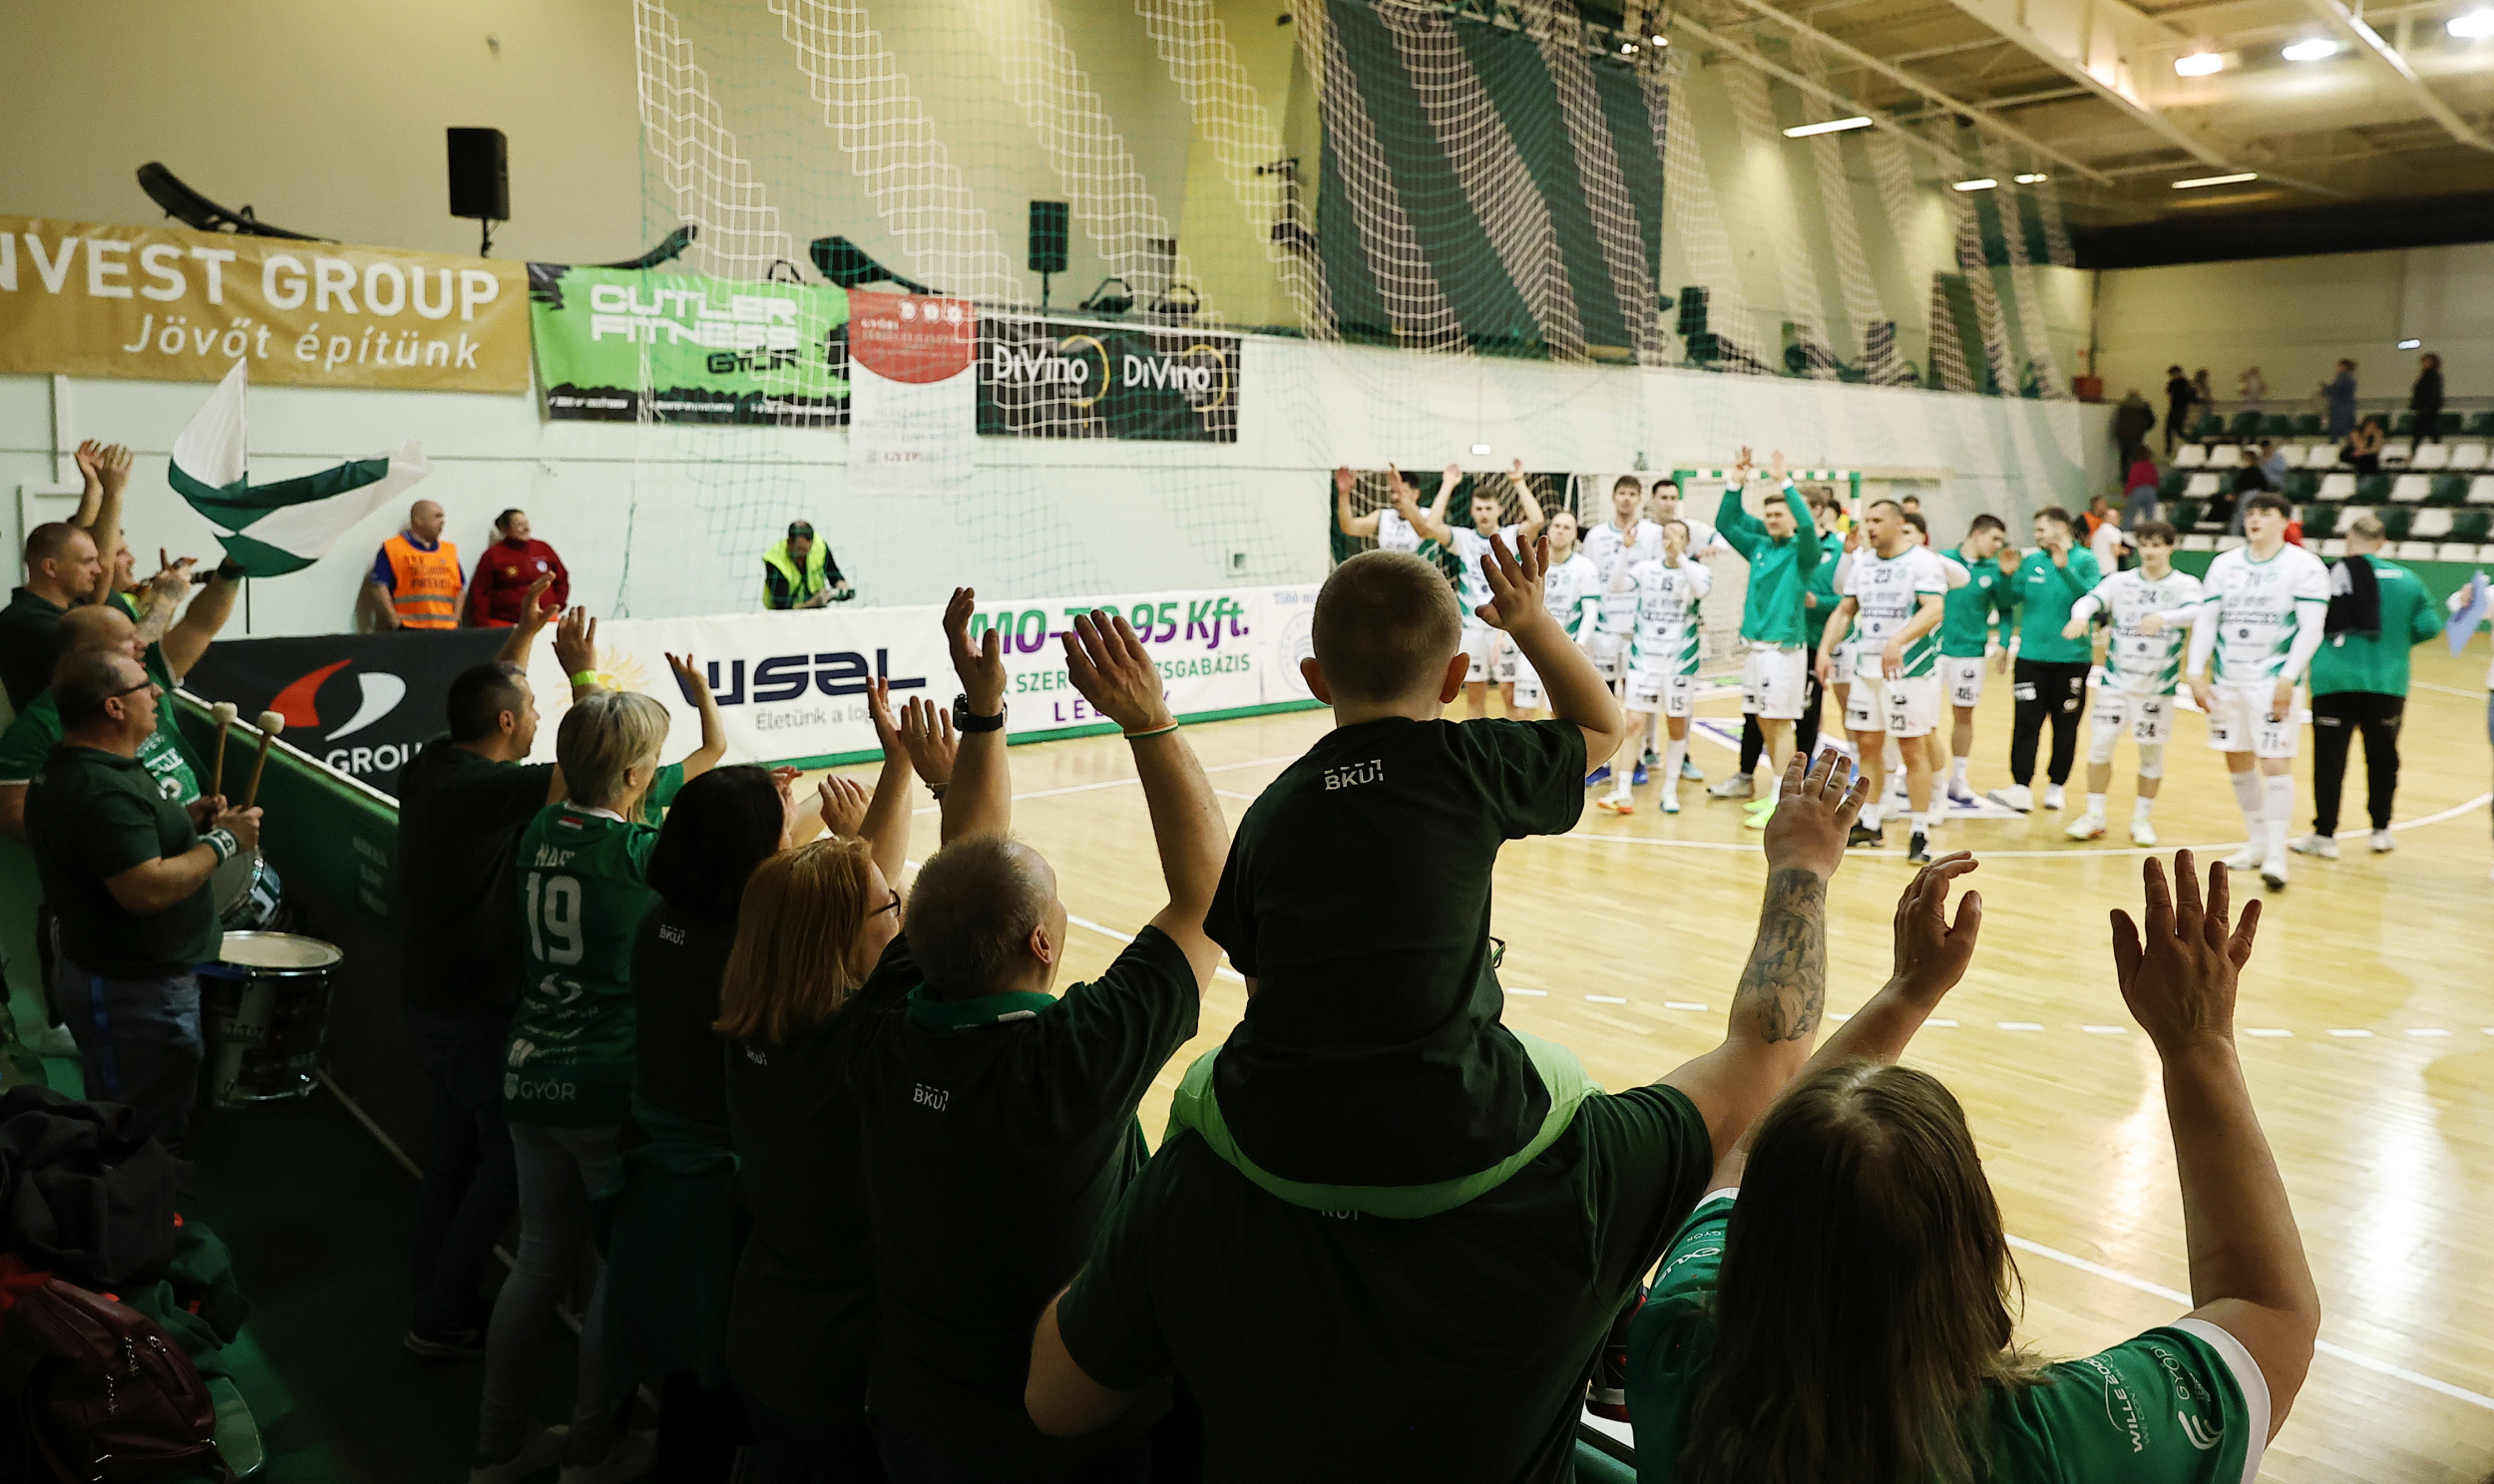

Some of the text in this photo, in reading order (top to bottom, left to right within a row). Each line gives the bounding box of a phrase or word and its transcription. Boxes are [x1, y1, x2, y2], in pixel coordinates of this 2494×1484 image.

[262, 253, 500, 322] GROUP
[590, 283, 798, 325] CUTLER
[123, 314, 481, 373] Jövőt építünk
[590, 313, 799, 349] FITNESS
[993, 344, 1089, 384] DiVino
[1123, 354, 1211, 392] DiVino
[1131, 602, 1178, 644] 95
[1186, 597, 1250, 649] Kft.
[832, 709, 844, 724] a
[1890, 714, 1906, 731] 23
[2135, 721, 2157, 738] 24
[526, 871, 585, 965] 19
[2114, 1387, 2143, 1453] WILLE
